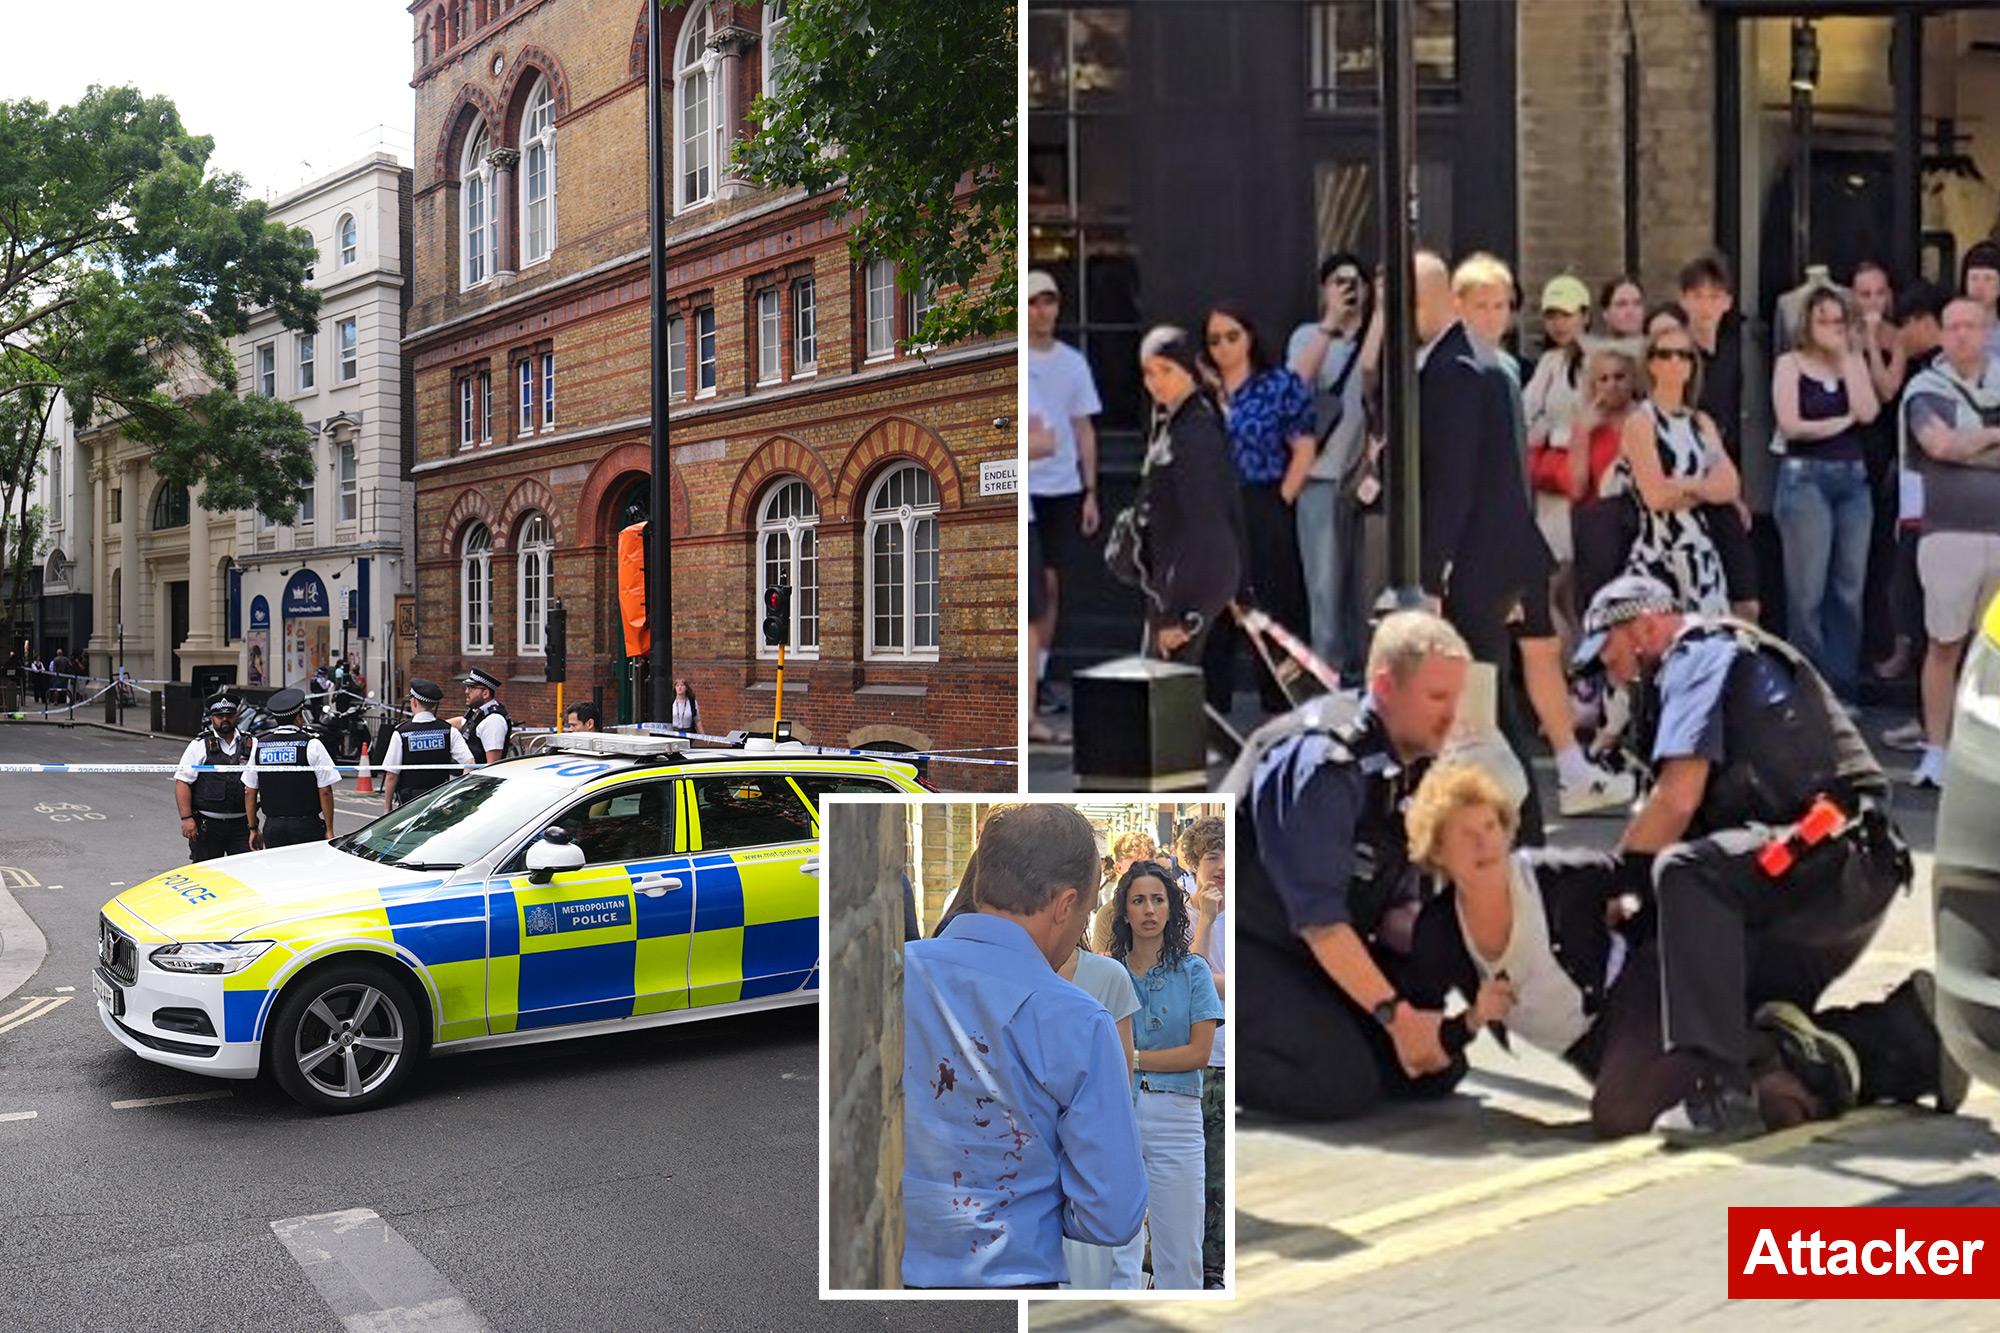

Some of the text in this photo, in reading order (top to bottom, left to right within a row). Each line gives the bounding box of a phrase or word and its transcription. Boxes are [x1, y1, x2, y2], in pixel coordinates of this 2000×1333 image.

[984, 469, 1017, 481] ENDELL
[984, 480, 1018, 492] STREET
[410, 739, 444, 750] POLICE
[261, 752, 295, 763] POLICE
[157, 874, 217, 905] POLICE
[562, 900, 625, 915] METROPOLITAN
[572, 912, 618, 926] POLICE
